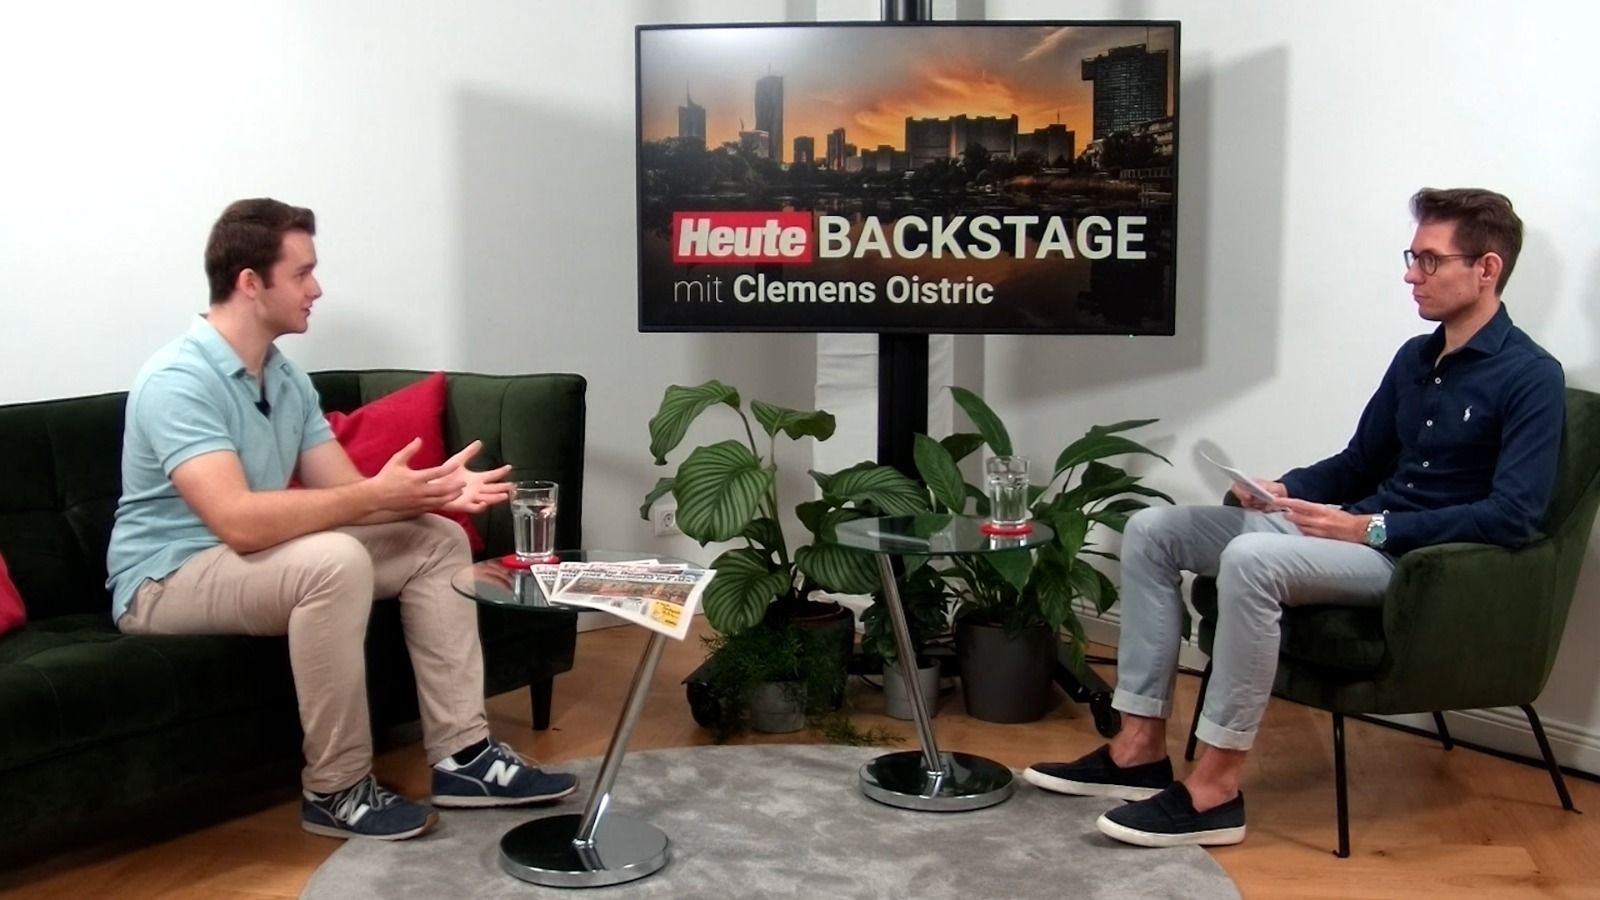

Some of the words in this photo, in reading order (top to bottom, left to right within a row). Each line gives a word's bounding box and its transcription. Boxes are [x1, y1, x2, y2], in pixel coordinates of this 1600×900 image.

[678, 218, 806, 257] Heute
[819, 215, 1147, 259] BACKSTAGE
[674, 275, 722, 303] mit
[733, 274, 876, 303] Clemens
[886, 276, 994, 304] Oistric
[483, 760, 519, 787] N
